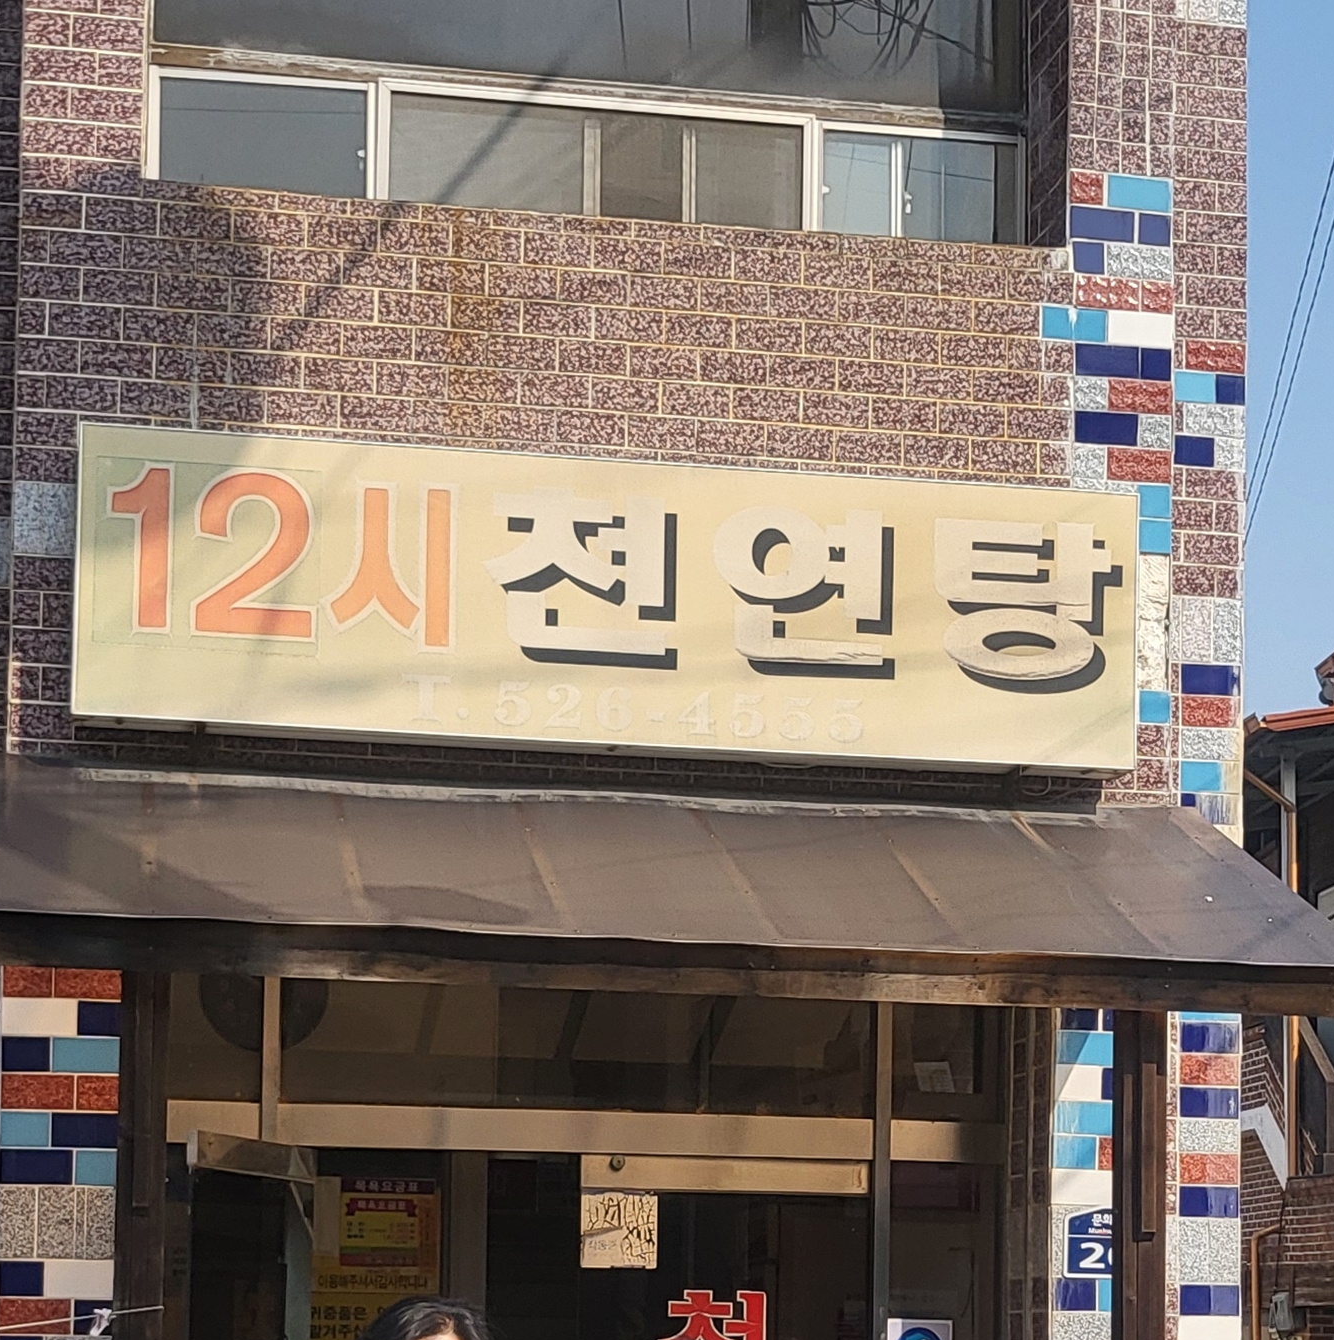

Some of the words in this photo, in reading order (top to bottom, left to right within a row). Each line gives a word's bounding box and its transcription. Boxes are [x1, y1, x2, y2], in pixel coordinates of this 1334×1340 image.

[108, 461, 459, 654] 12시
[493, 483, 1124, 693] 천연탕
[1079, 1241, 1113, 1270] 2
